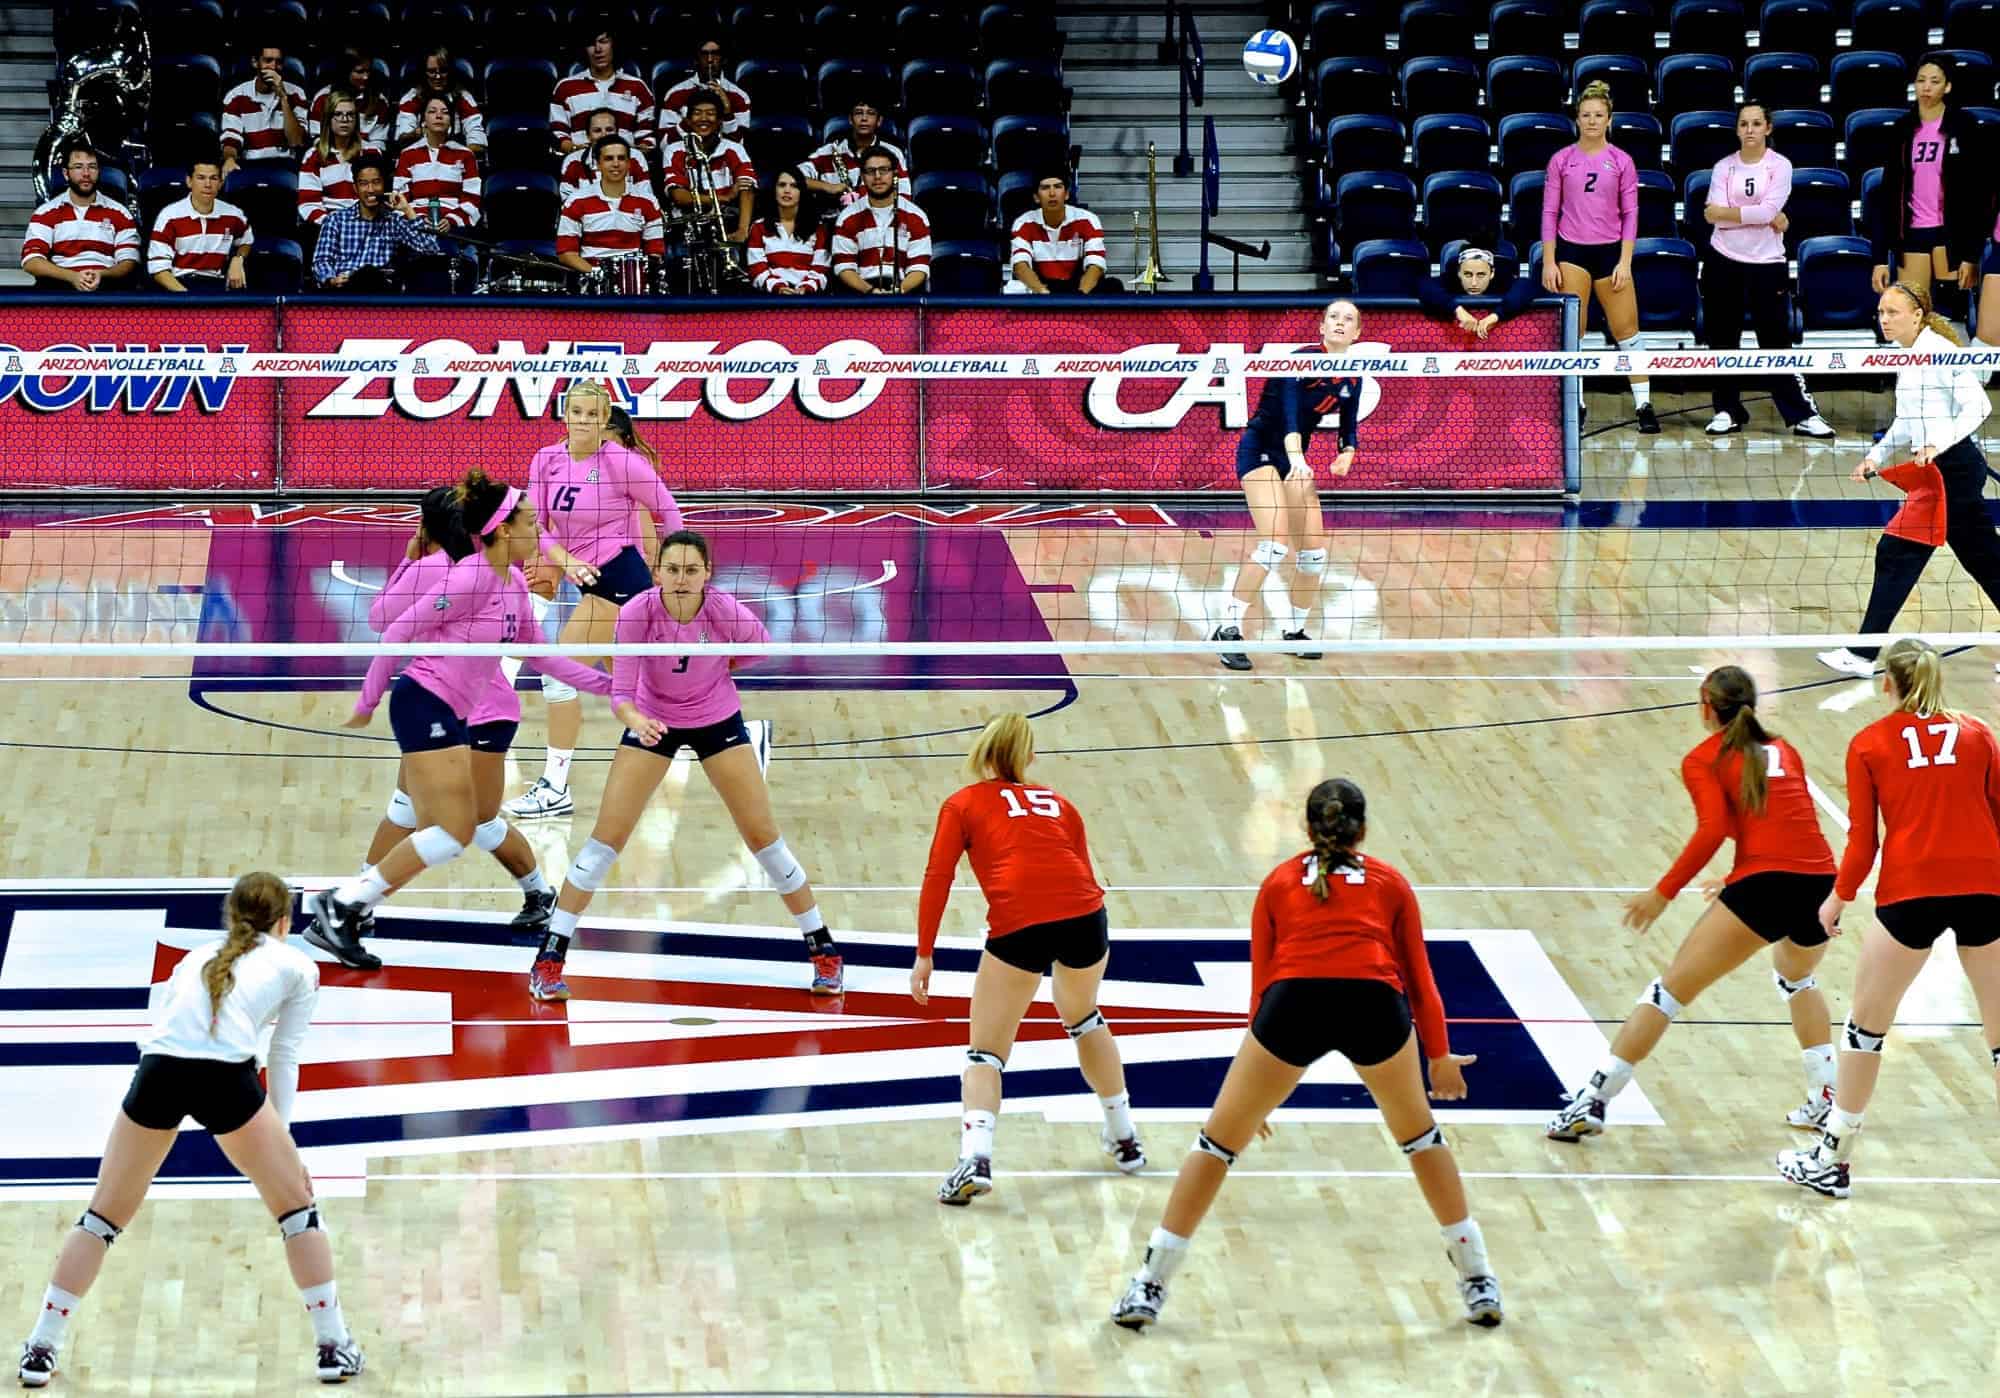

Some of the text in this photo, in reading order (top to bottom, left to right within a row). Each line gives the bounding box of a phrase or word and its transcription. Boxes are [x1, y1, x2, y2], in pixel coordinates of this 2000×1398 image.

[1914, 141, 1940, 163] 33
[1584, 172, 1598, 193] 2
[1745, 177, 1755, 197] 5
[38, 358, 206, 371] ARIZONAVOLLEYBALL
[252, 359, 397, 372] ARIZONAWILDCATS
[444, 360, 609, 373] ARIZONAVOLLEYBALL
[654, 360, 798, 373] ARIZONAWILDCATS
[844, 361, 1009, 373] ARIZONAVOLLEYBALL
[1054, 360, 1198, 373] ARIZONAWILDCATS
[1244, 359, 1409, 372] ARIZONAVOLLEYBALL
[1455, 358, 1600, 371] ARIZONAWILDCATS
[1648, 355, 1815, 369] ARIZONAVOLLEYBALL
[1861, 352, 2000, 367] ARIZONAWILDCAT
[1086, 342, 1391, 429] CA
[552, 485, 581, 512] 15
[37, 502, 1178, 527] ARONA
[1902, 723, 1958, 768] 17
[999, 788, 1061, 818] 15
